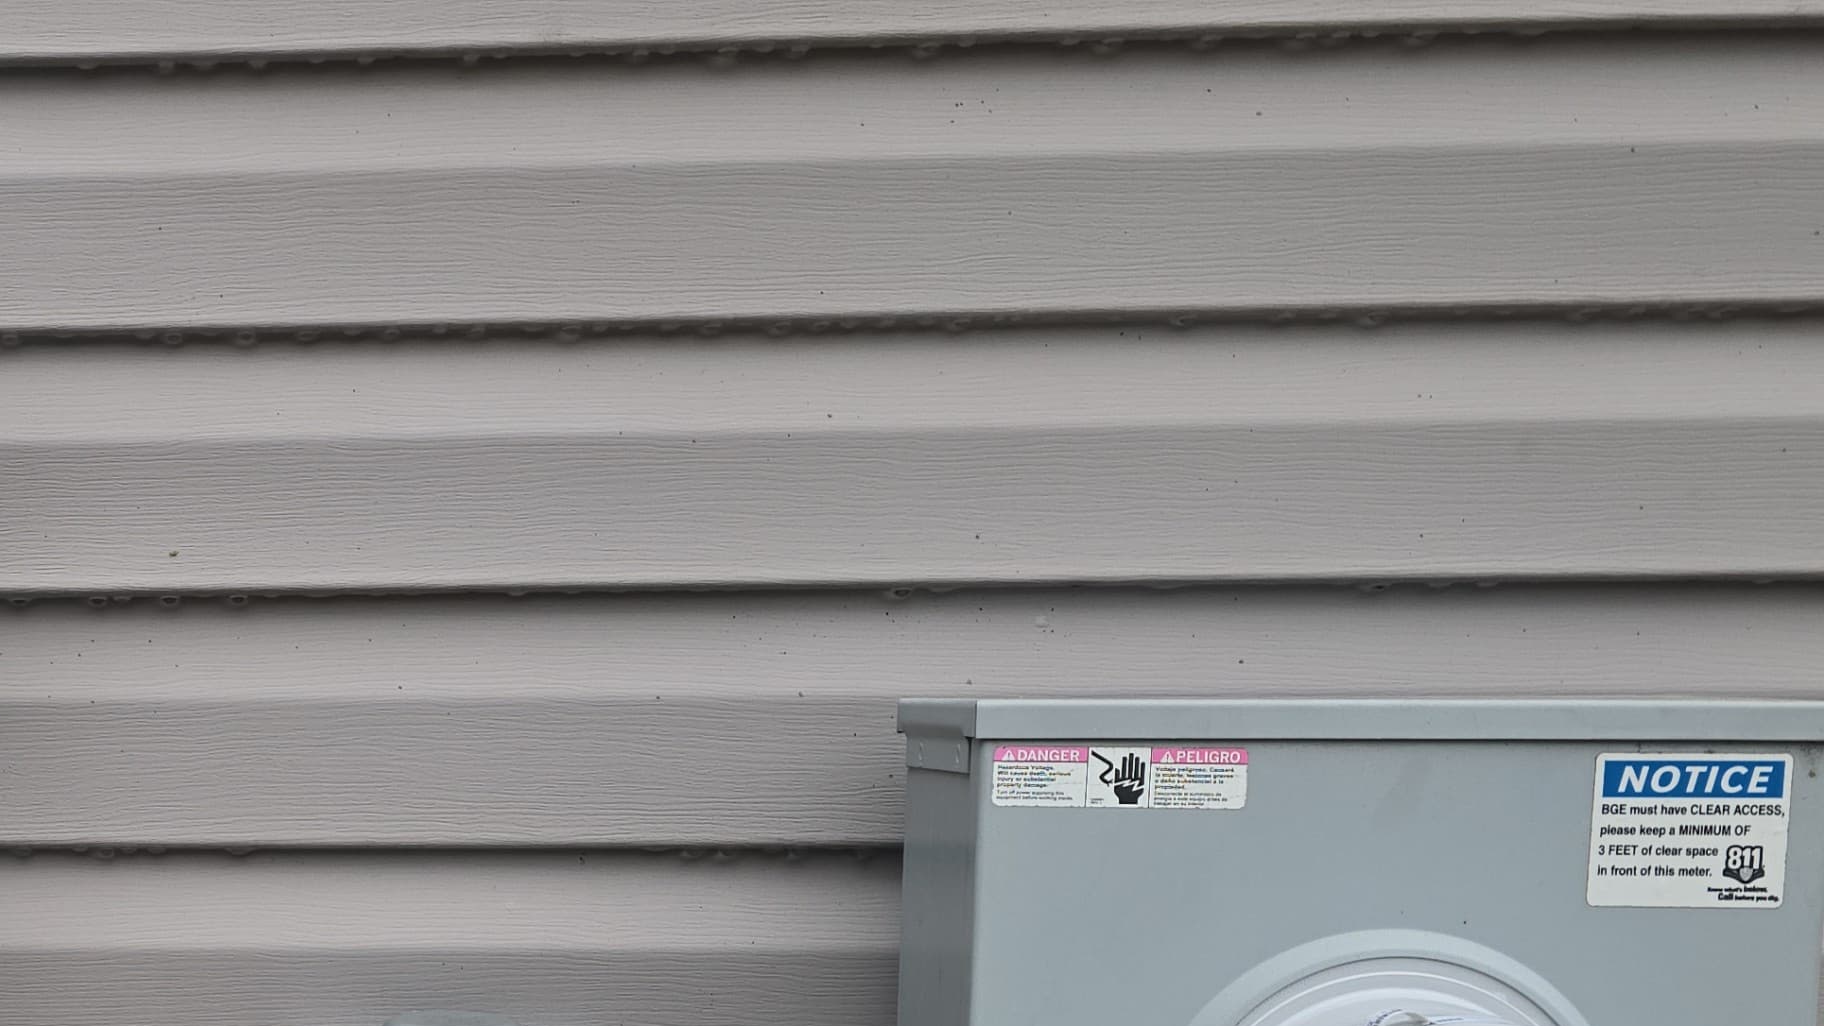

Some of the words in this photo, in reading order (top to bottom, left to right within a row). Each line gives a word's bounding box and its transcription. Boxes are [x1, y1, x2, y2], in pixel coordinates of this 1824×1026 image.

[1017, 749, 1080, 762] DANGER
[1177, 750, 1241, 763] PELIGRO
[1618, 765, 1774, 794] NOTICE
[1601, 804, 1626, 815] BGE
[1629, 805, 1658, 815] must
[1660, 804, 1687, 815] have
[1690, 805, 1730, 816] CLEAR
[1733, 805, 1785, 818] ACCESS,
[1600, 825, 1636, 838] please
[1639, 825, 1666, 838] keep
[1668, 827, 1676, 836] a
[1679, 825, 1731, 836] MINIMUM
[1734, 824, 1751, 836] OF
[1598, 845, 1605, 856] 3
[1608, 845, 1638, 856] FEET
[1641, 845, 1653, 856] of
[1655, 845, 1682, 856] clear
[1685, 847, 1719, 859] space
[1728, 846, 1761, 870] 811
[1597, 866, 1608, 876] in
[1610, 865, 1637, 876] front
[1640, 865, 1653, 877] of
[1654, 865, 1675, 877] this
[1678, 867, 1713, 877] meter.
